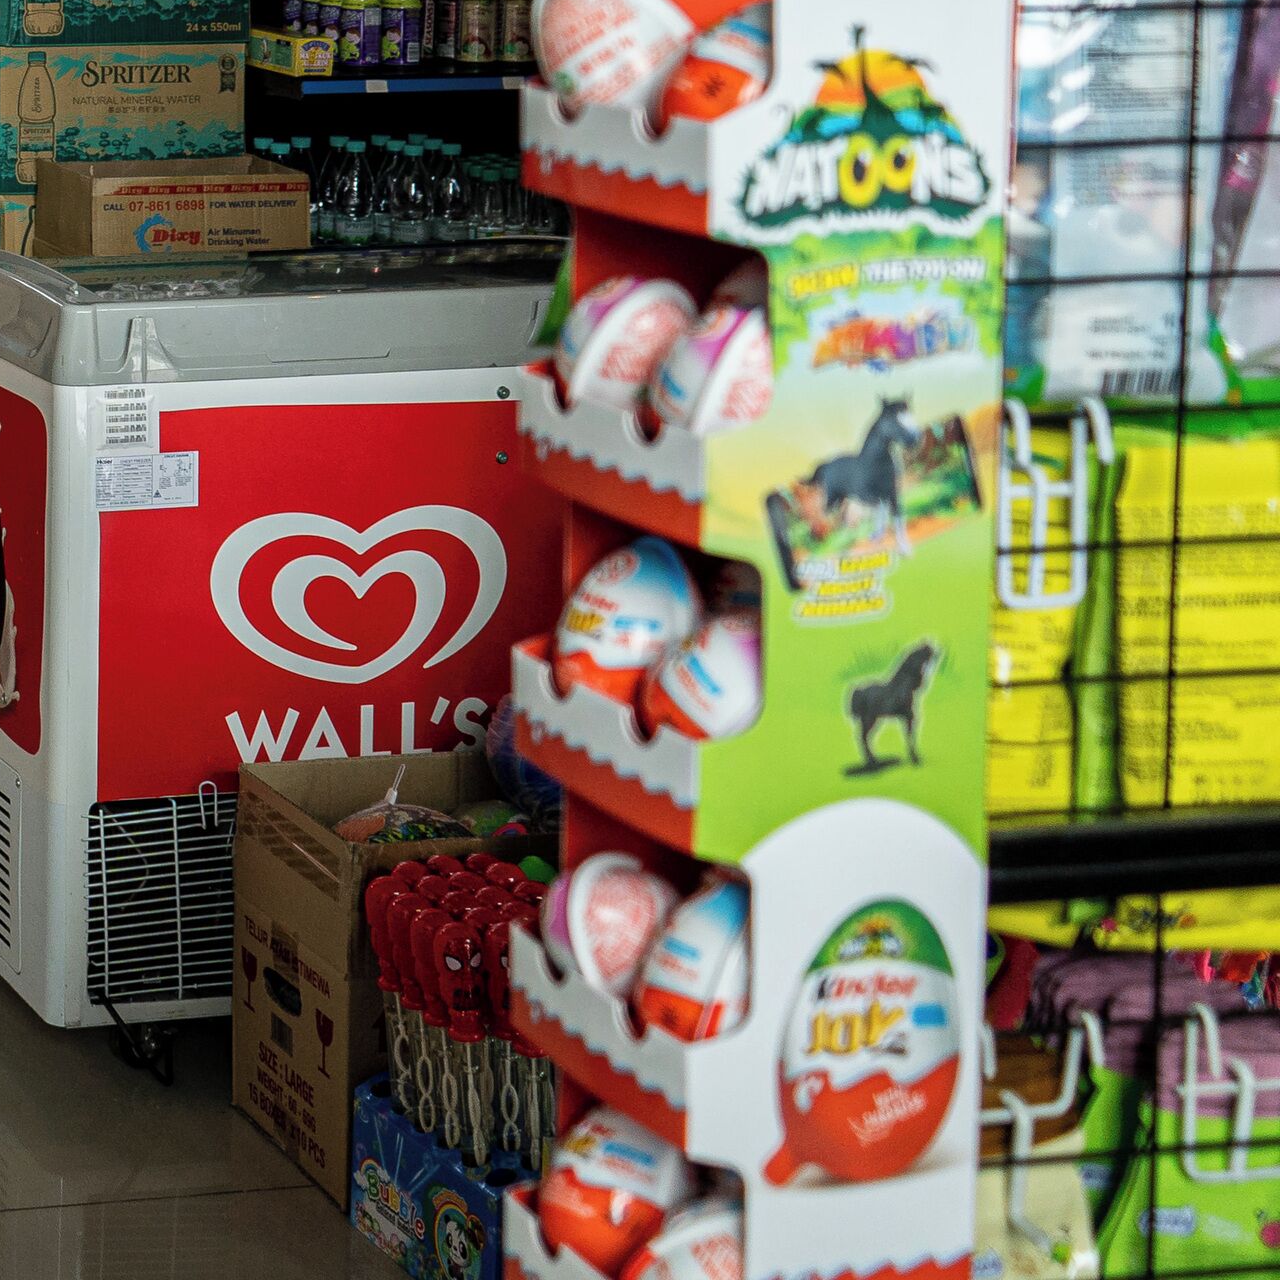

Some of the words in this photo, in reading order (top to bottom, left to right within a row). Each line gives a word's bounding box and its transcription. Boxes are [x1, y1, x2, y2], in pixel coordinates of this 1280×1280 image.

[186, 23, 199, 32] 24
[210, 22, 241, 32] 550ml
[81, 61, 191, 87] SPRITZER
[73, 96, 119, 106] NATURAL
[121, 95, 165, 105] MINERAL
[167, 95, 201, 104] WATER
[745, 133, 988, 215] NATOONS
[104, 203, 124, 211] CALL
[128, 201, 171, 212] 07-861
[176, 200, 205, 211] 6898
[210, 201, 227, 209] FOR
[228, 200, 257, 208] WATER
[258, 199, 298, 208] DELIVERY
[151, 228, 202, 244] Dixy
[208, 228, 220, 236] Air
[208, 237, 244, 246] Drinking
[246, 237, 270, 245] Water
[226, 696, 488, 764] WALL'S
[258, 1041, 278, 1072] SIZE
[284, 1069, 315, 1108] LARGE
